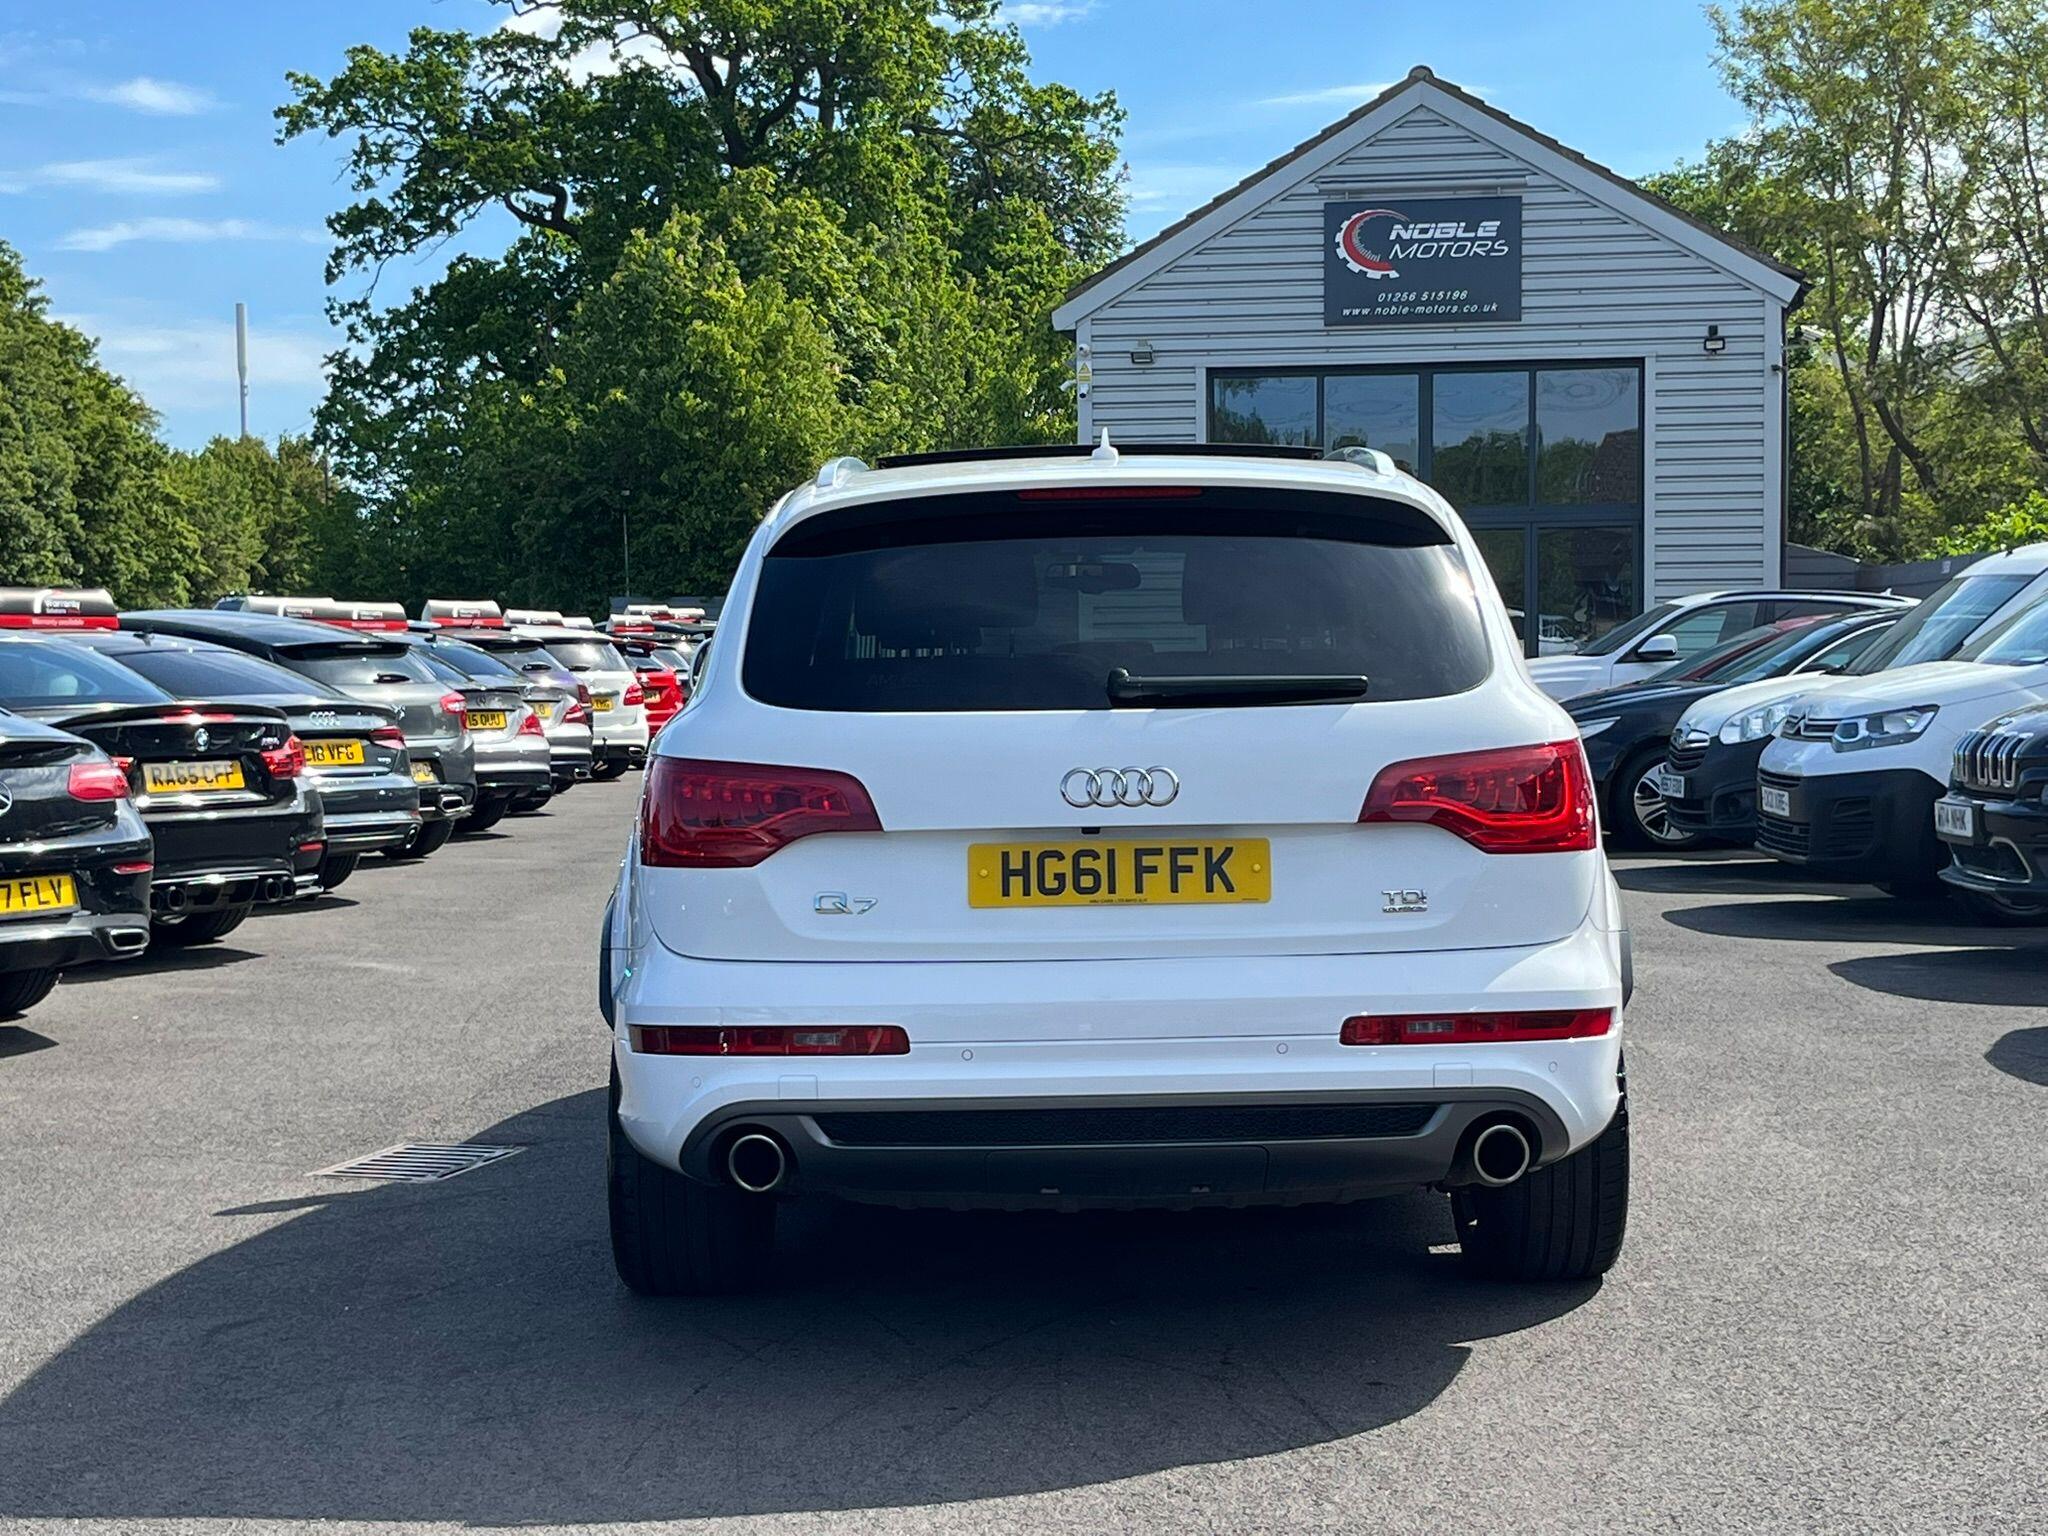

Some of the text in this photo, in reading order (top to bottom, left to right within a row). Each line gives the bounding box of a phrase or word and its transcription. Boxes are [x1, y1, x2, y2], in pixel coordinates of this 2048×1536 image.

[1389, 221, 1501, 241] NOBLE
[1388, 240, 1509, 260] MOTORS
[1377, 291, 1417, 303] 01256
[1342, 302, 1499, 316] www.noble-motors.co.uk
[326, 744, 354, 761] VFG
[1001, 847, 1235, 897] HG61 FFK
[19, 879, 62, 907] FLV
[814, 891, 878, 915] Q7
[1381, 889, 1427, 905] TDI
